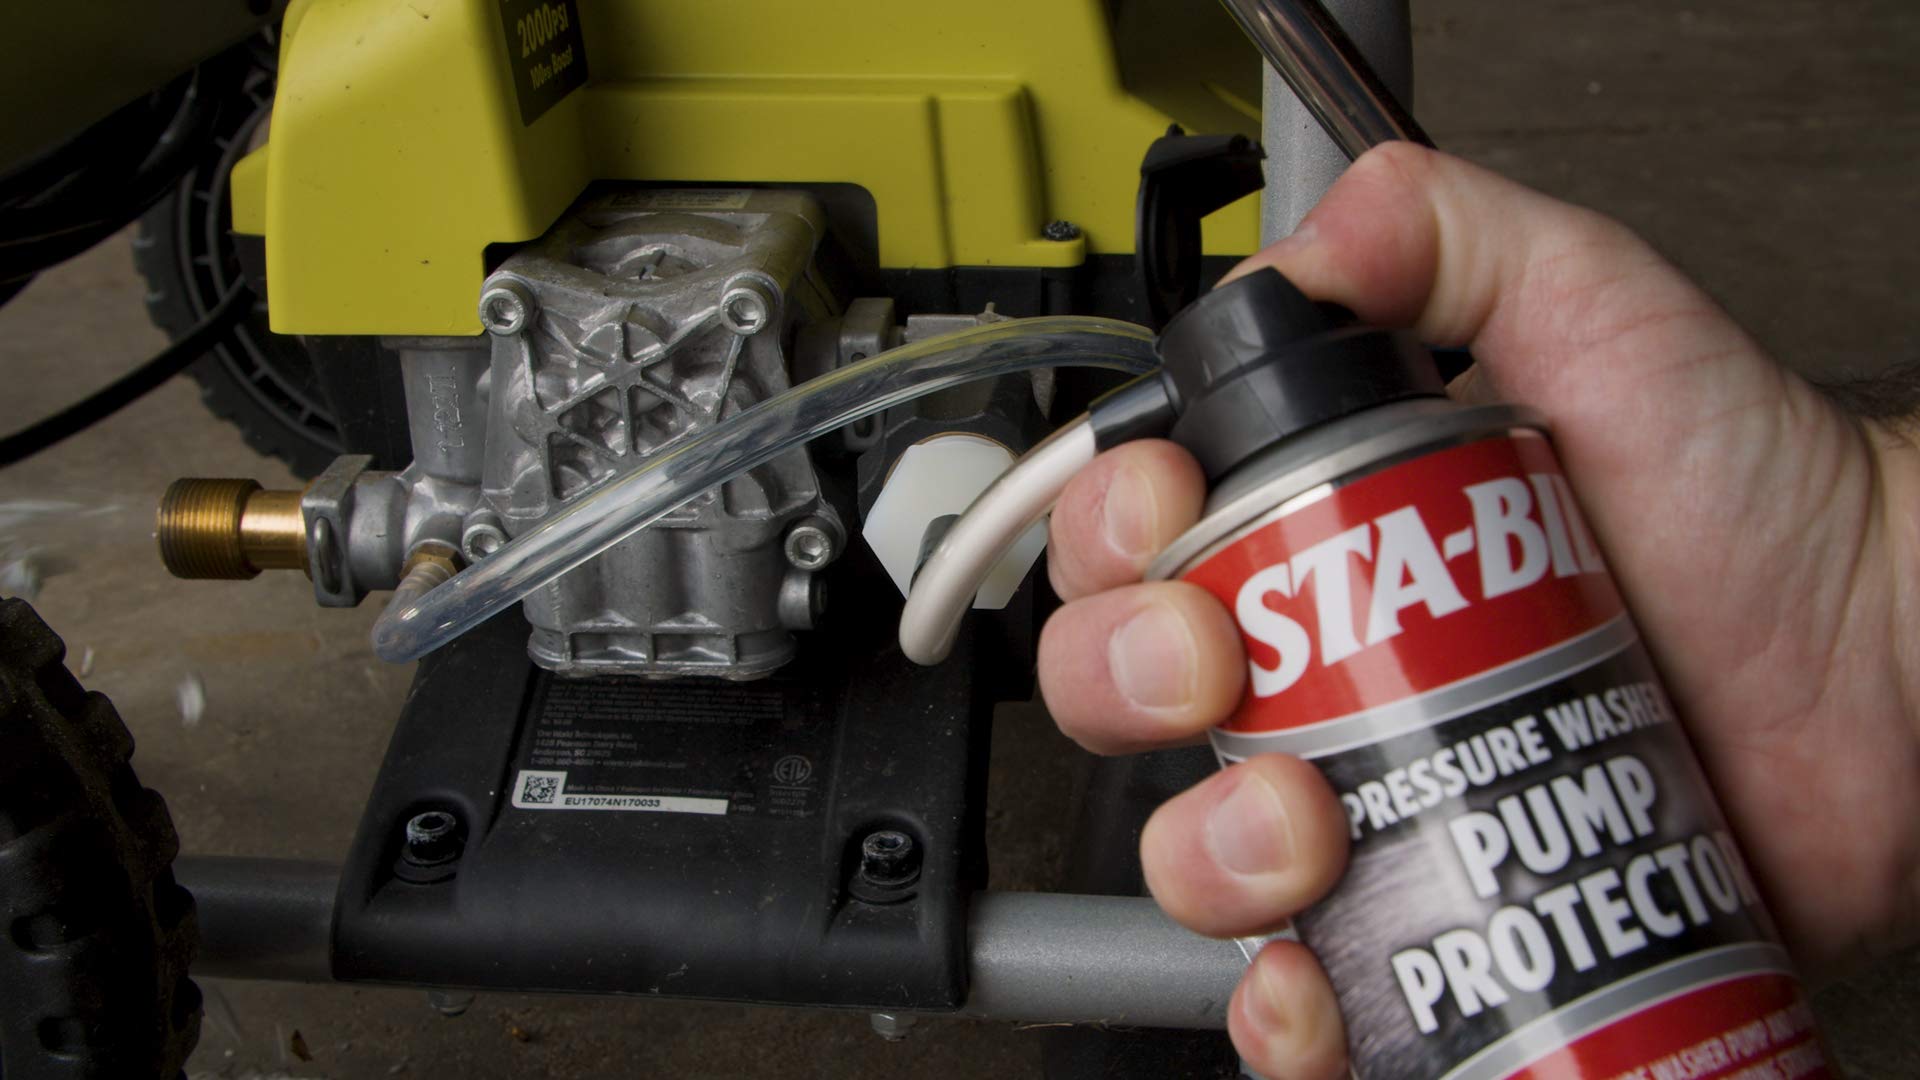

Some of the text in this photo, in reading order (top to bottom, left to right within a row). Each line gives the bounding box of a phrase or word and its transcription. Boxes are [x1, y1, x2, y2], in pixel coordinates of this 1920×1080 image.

[1235, 472, 1605, 699] STA-BIL
[564, 796, 661, 808] EU17074N170033
[1341, 715, 1552, 841] PRESSURE
[1448, 754, 1658, 899] PUMP
